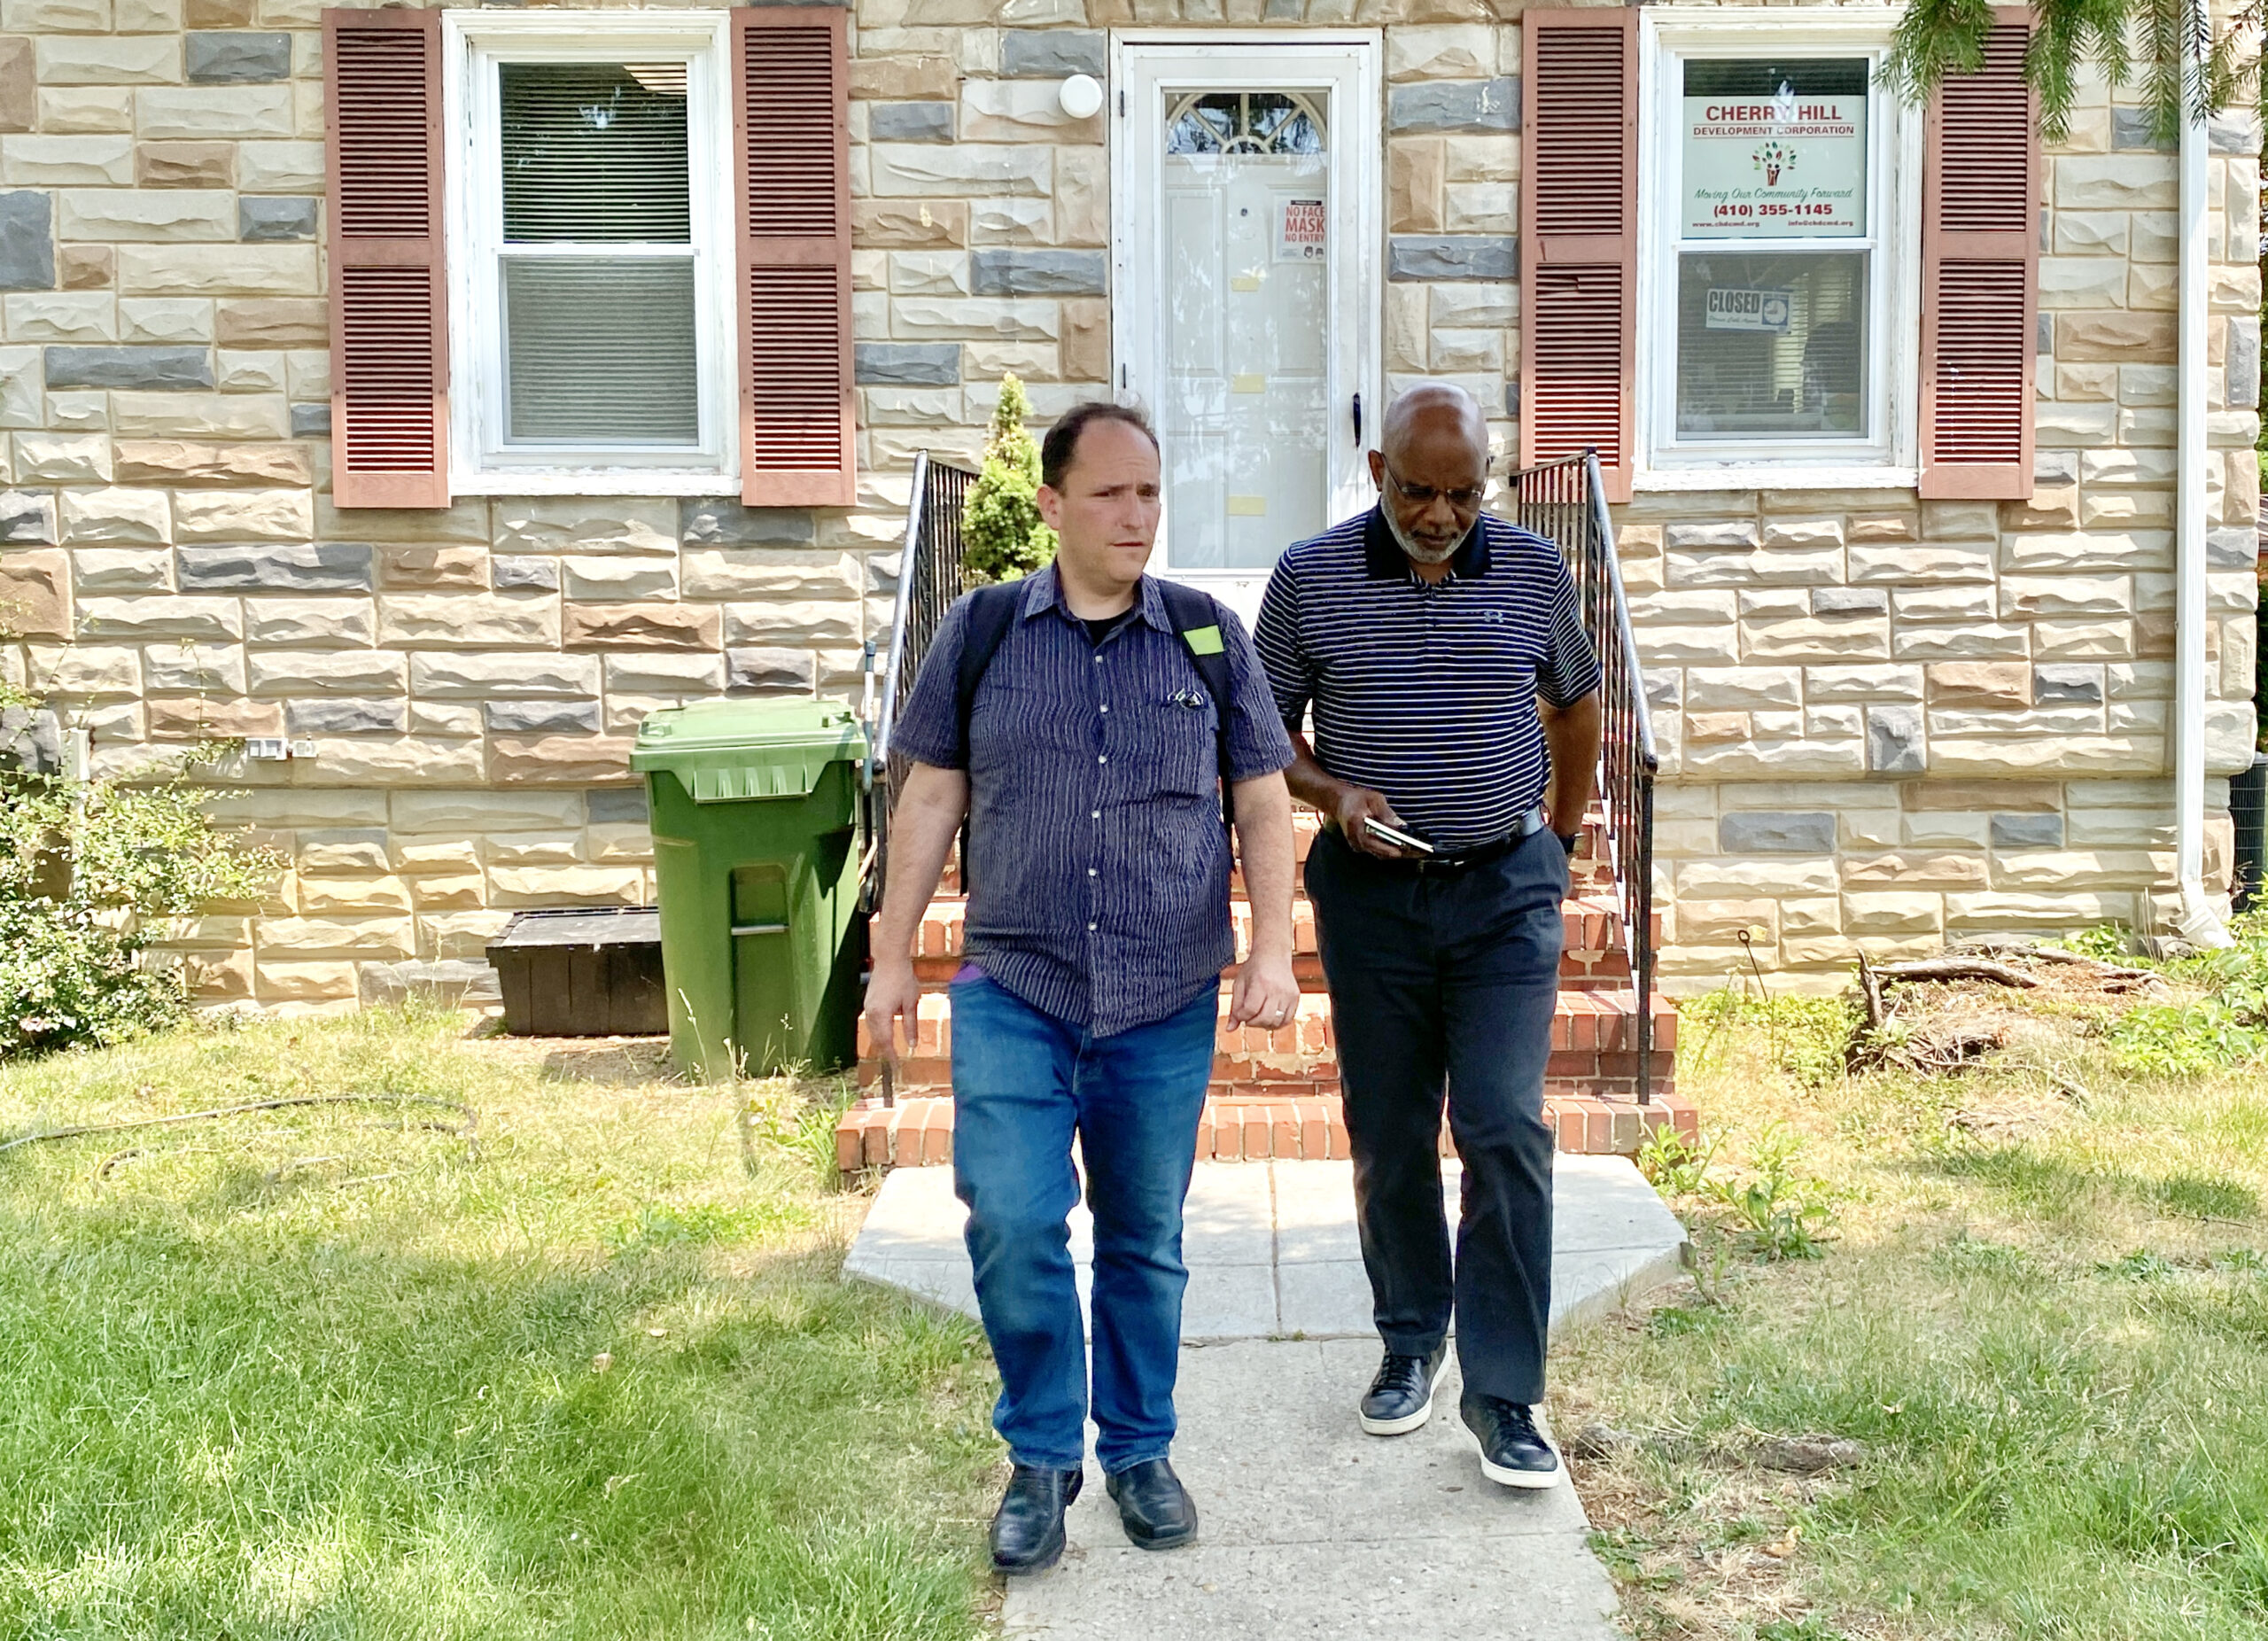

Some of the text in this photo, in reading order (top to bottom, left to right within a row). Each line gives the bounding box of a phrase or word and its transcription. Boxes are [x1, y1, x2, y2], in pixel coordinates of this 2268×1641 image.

[1705, 105, 1842, 121] CHERRY HILL
[1693, 125, 1854, 136] DEVELOPMENT CORPORATION
[1694, 187, 1853, 203] Moving Our Community Forward
[1286, 206, 1324, 217] NO FACE
[1713, 204, 1832, 218] (410) 355-1145
[1285, 218, 1325, 232] MASK
[1285, 233, 1324, 243] NO ENTRY
[1708, 291, 1760, 314] CLOSED
